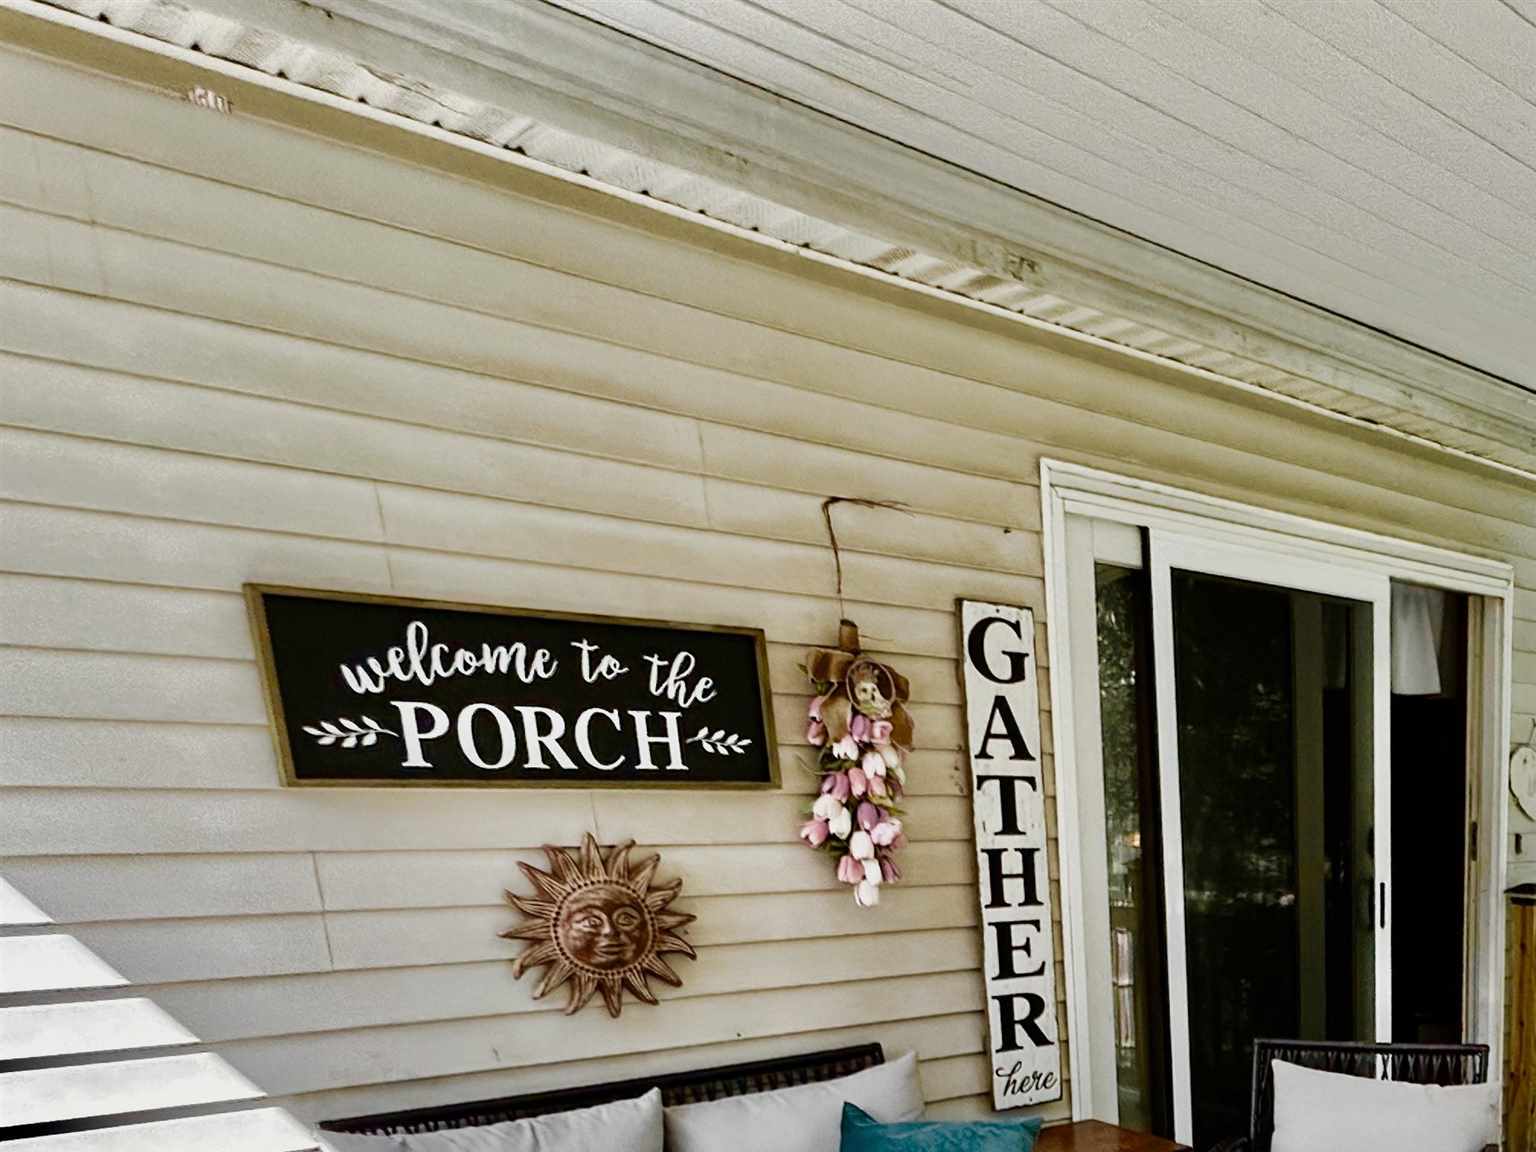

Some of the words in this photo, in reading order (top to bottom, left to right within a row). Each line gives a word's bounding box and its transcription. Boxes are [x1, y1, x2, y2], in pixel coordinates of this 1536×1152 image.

[340, 621, 559, 694] welcome
[571, 639, 629, 683] to
[643, 651, 717, 708] the
[389, 701, 689, 771] PORCH
[968, 616, 1055, 1054] GATHER
[996, 1061, 1058, 1097] here
